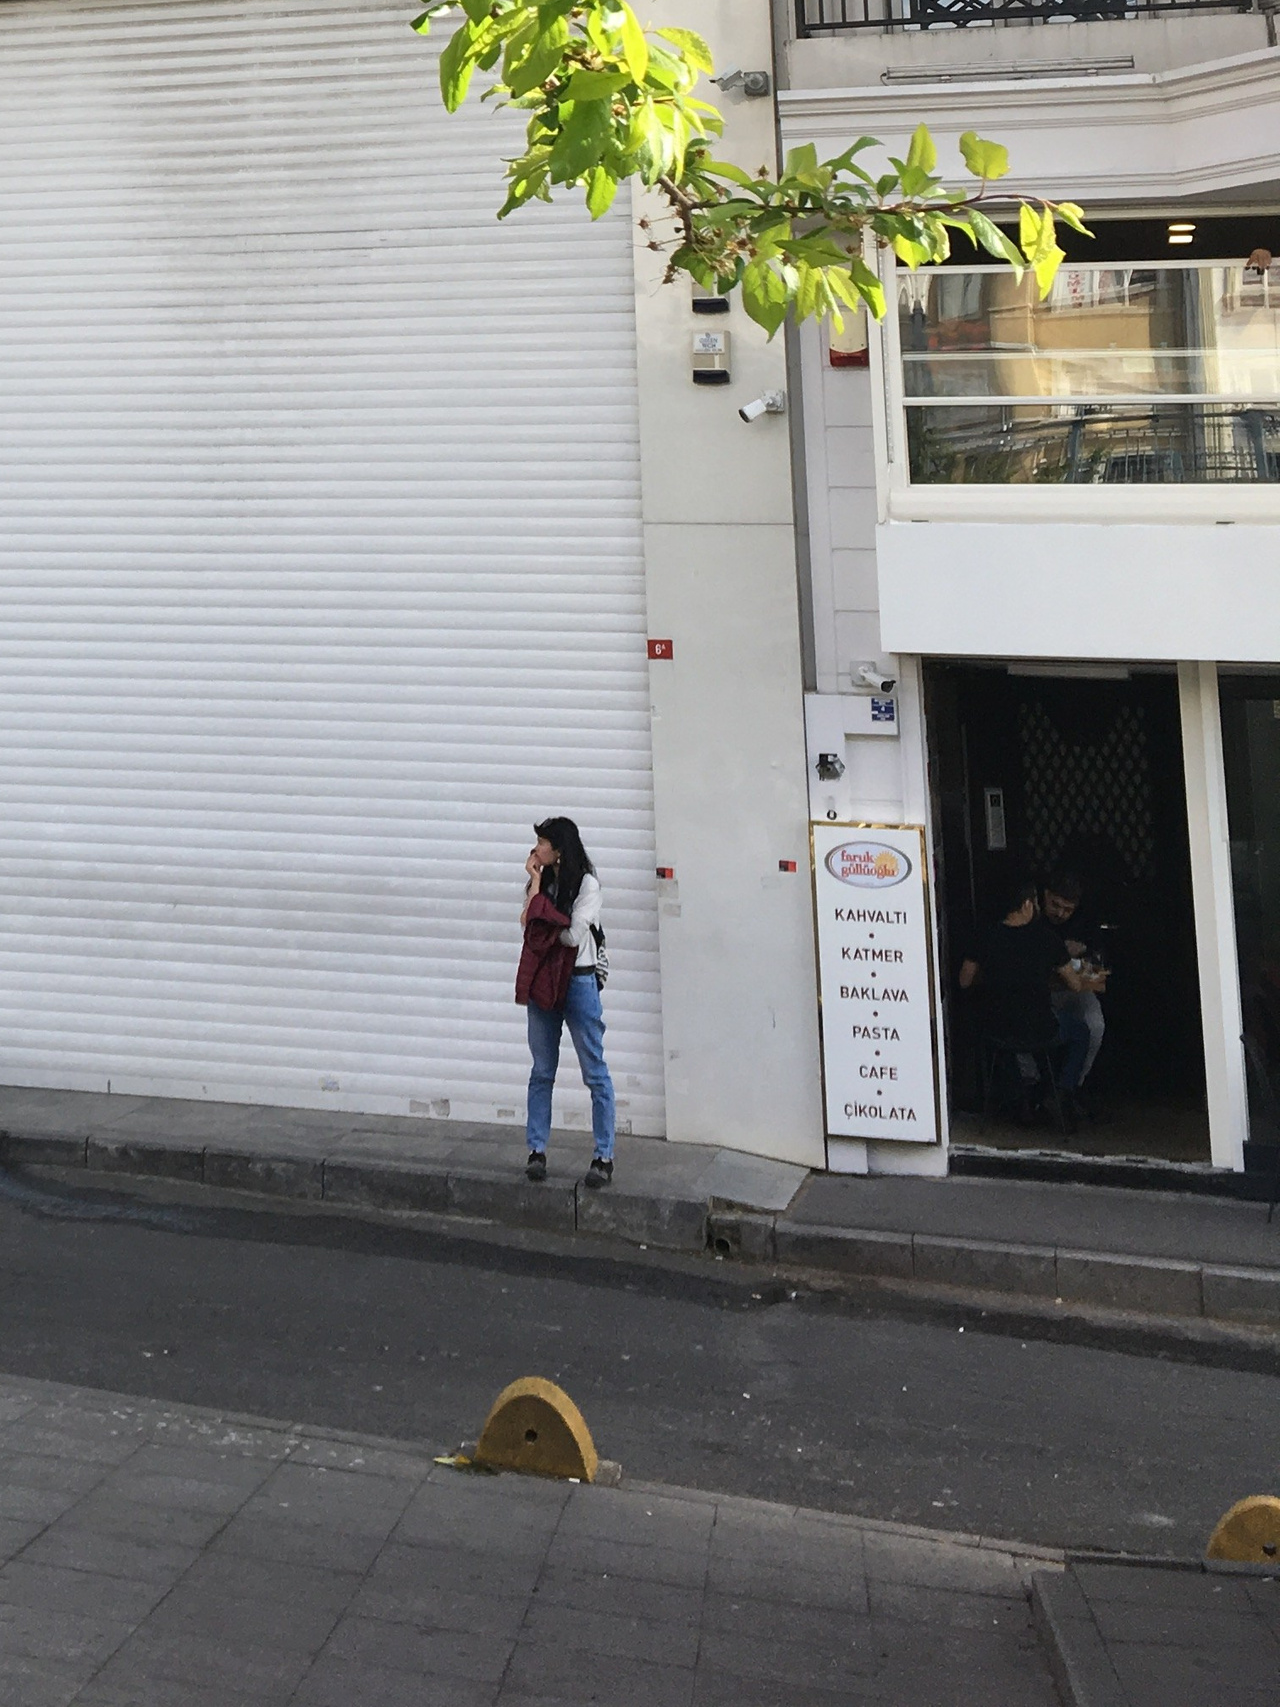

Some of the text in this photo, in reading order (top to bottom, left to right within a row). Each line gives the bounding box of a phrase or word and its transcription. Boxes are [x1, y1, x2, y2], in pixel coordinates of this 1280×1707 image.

[840, 850, 875, 863] faruk
[834, 907, 908, 925] KAHVALTI
[841, 947, 904, 964] KATMER
[839, 985, 910, 1003] BAKLAVA
[852, 1025, 901, 1041] PASTA
[859, 1065, 899, 1081] CAFE
[844, 1100, 918, 1122] ÇİKOLATA
